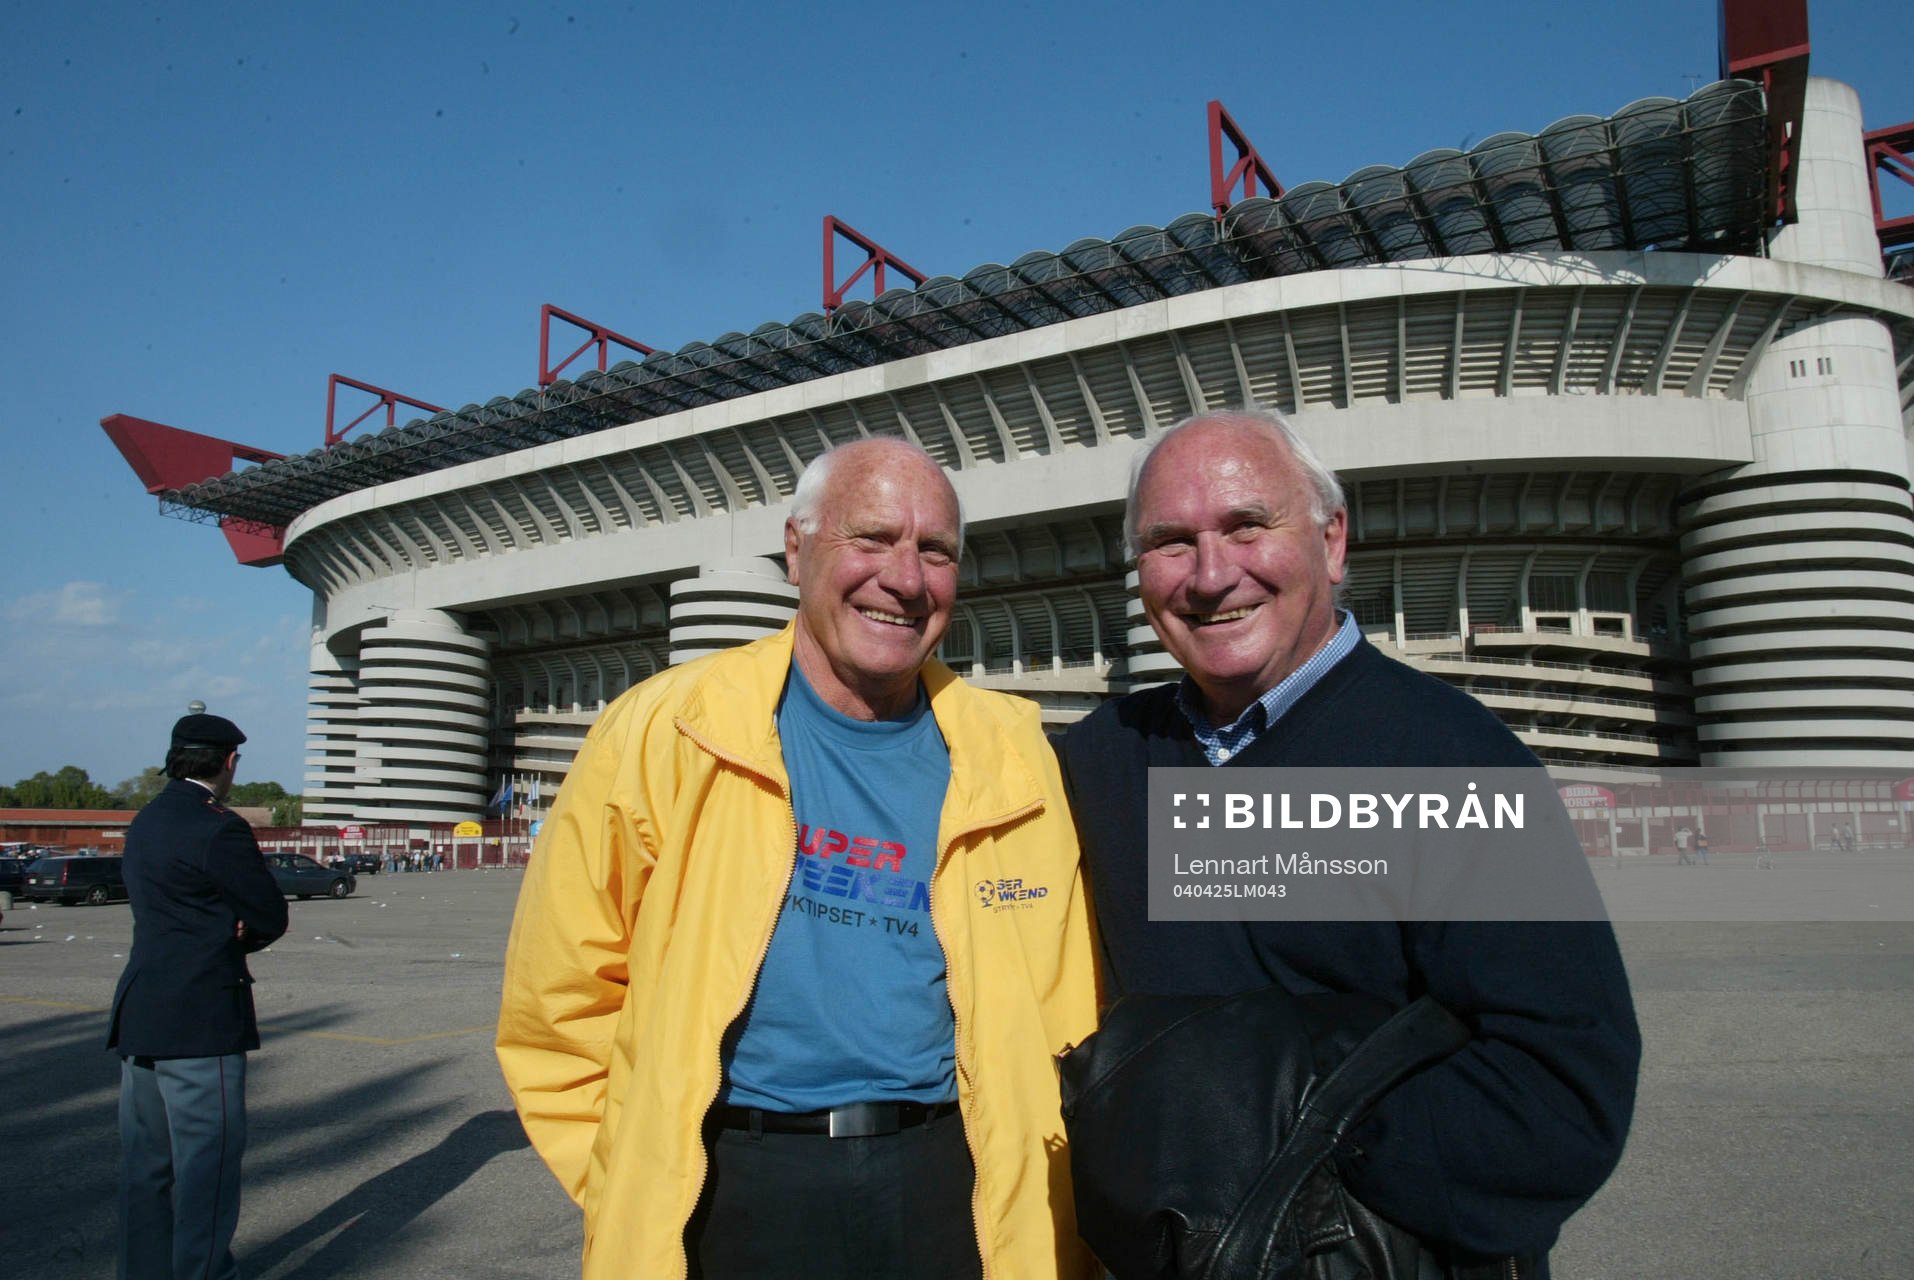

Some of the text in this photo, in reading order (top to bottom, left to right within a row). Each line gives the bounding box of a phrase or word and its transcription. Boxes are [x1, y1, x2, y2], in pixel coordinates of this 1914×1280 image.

[797, 824, 906, 873] UPER
[793, 854, 931, 912] EEKEN
[883, 916, 919, 937] TV4
